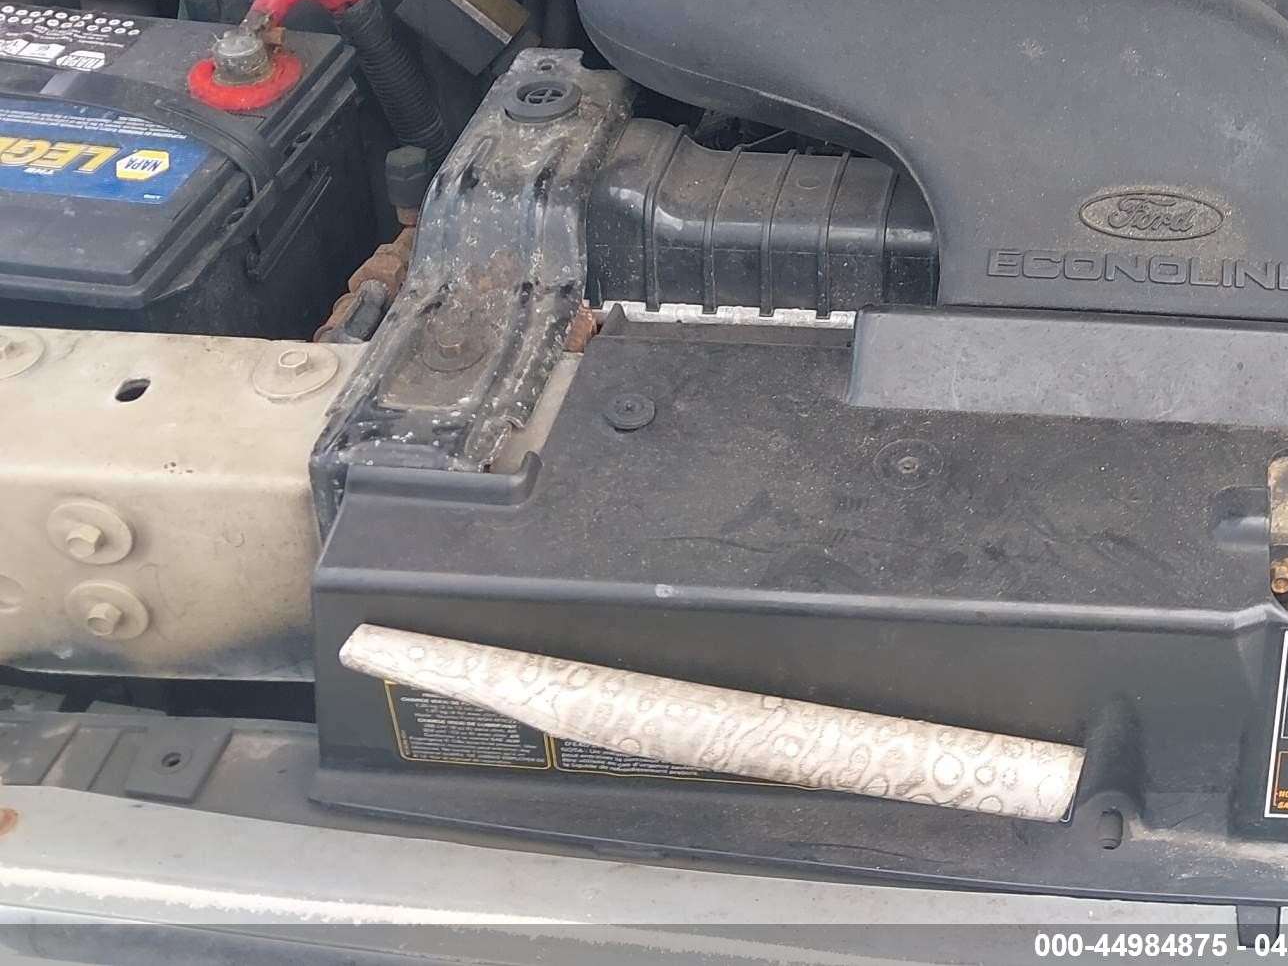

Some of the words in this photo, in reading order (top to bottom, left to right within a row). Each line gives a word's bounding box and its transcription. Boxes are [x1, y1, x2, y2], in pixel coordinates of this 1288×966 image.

[0, 136, 120, 173] LEG
[124, 157, 162, 171] NAPA
[1107, 197, 1195, 233] Ford
